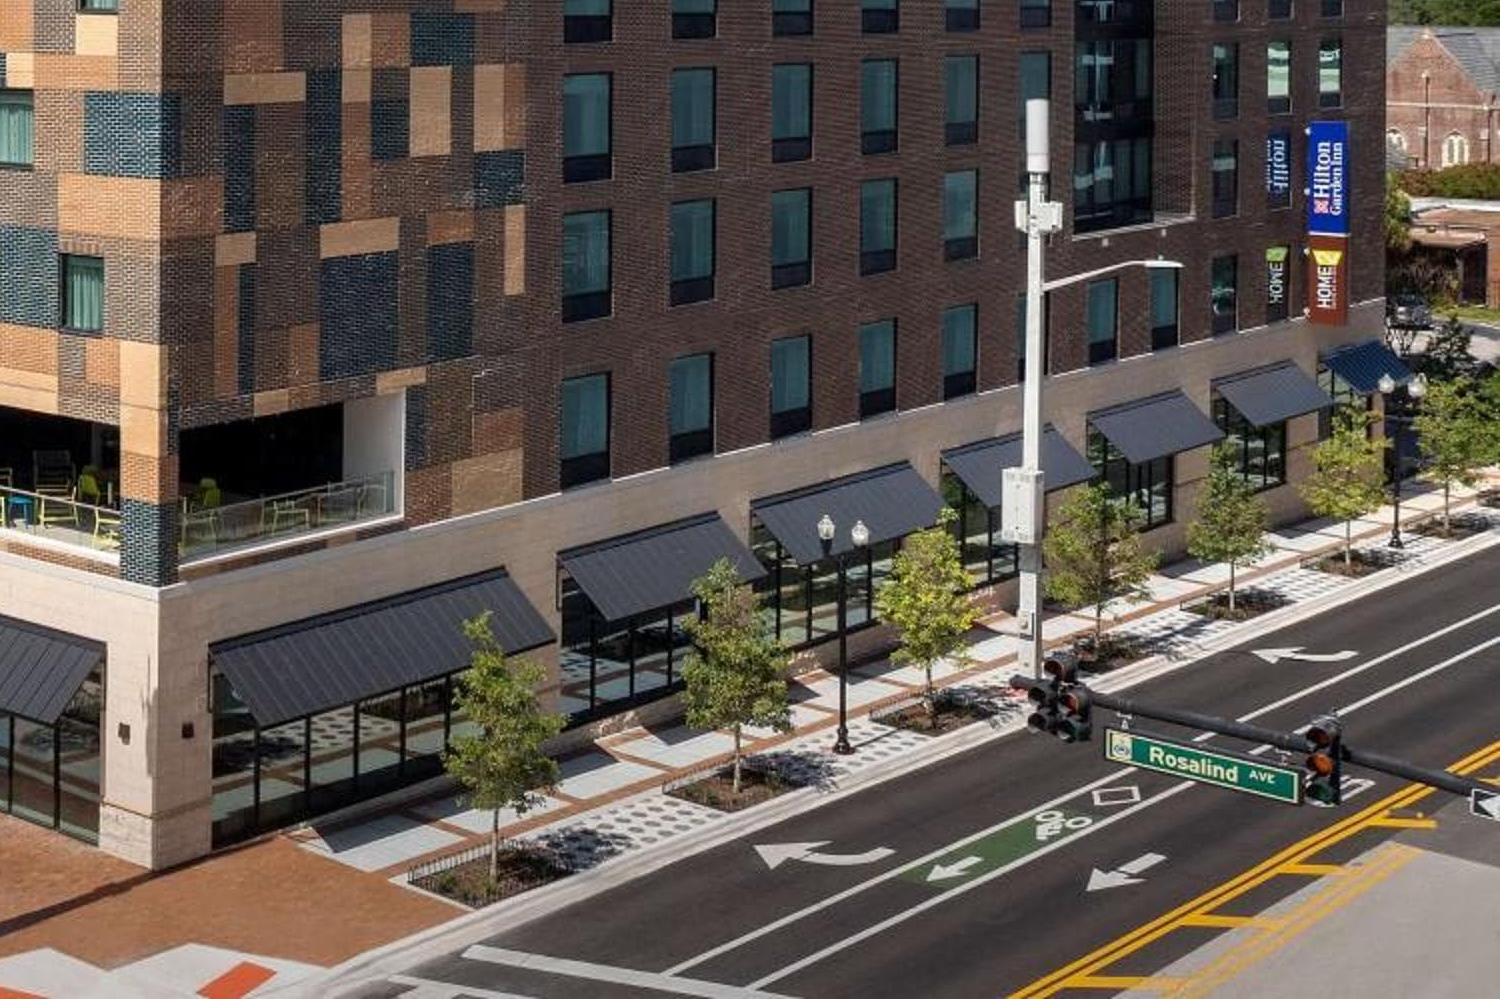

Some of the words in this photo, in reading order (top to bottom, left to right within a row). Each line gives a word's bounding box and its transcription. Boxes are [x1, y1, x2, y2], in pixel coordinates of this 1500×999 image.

[1314, 142, 1331, 198] Hilton
[1149, 745, 1239, 783] Rosalind
[1249, 770, 1277, 784] AVE
